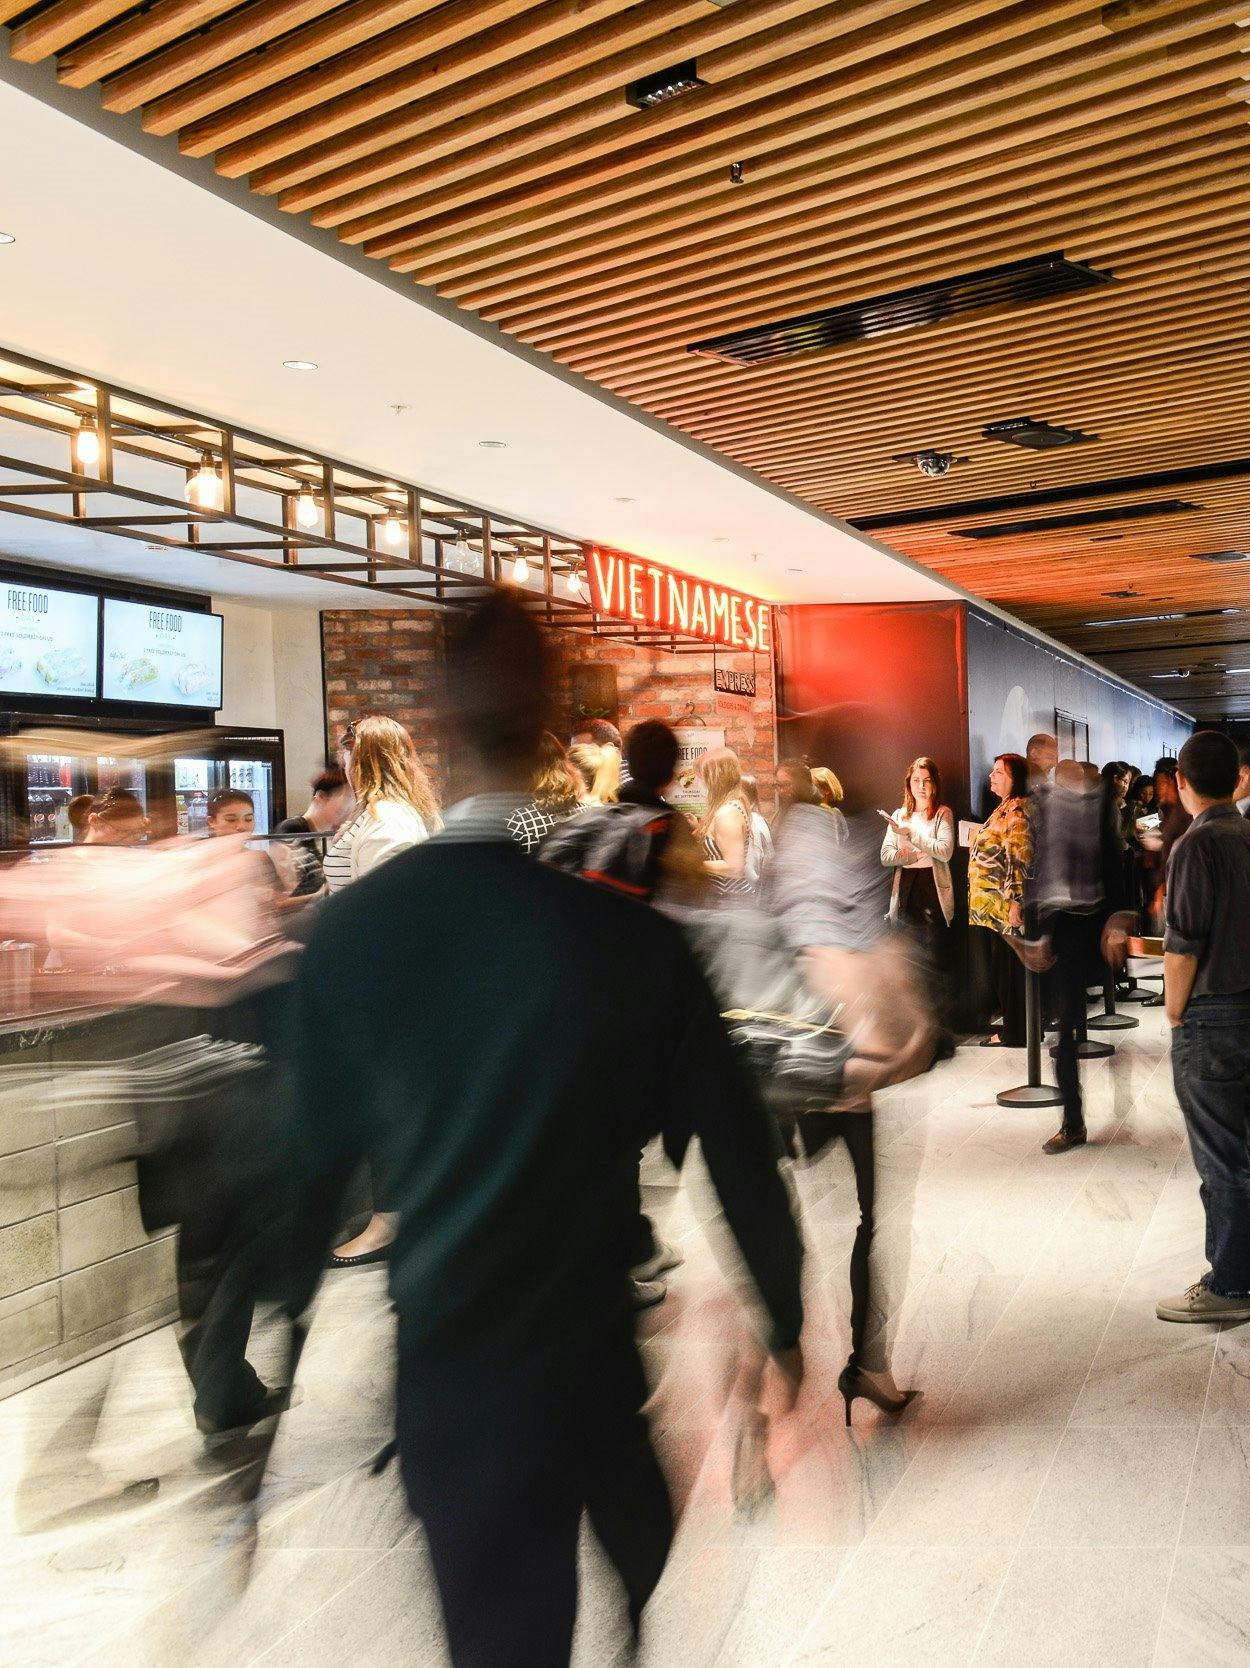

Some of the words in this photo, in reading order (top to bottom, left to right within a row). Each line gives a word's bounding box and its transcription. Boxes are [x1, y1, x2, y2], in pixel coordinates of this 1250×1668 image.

[7, 589, 26, 611] FREE
[28, 592, 48, 614] FOOD
[592, 551, 771, 651] VIETNAMESE
[149, 610, 164, 631] FREE
[165, 613, 182, 633] FOOD
